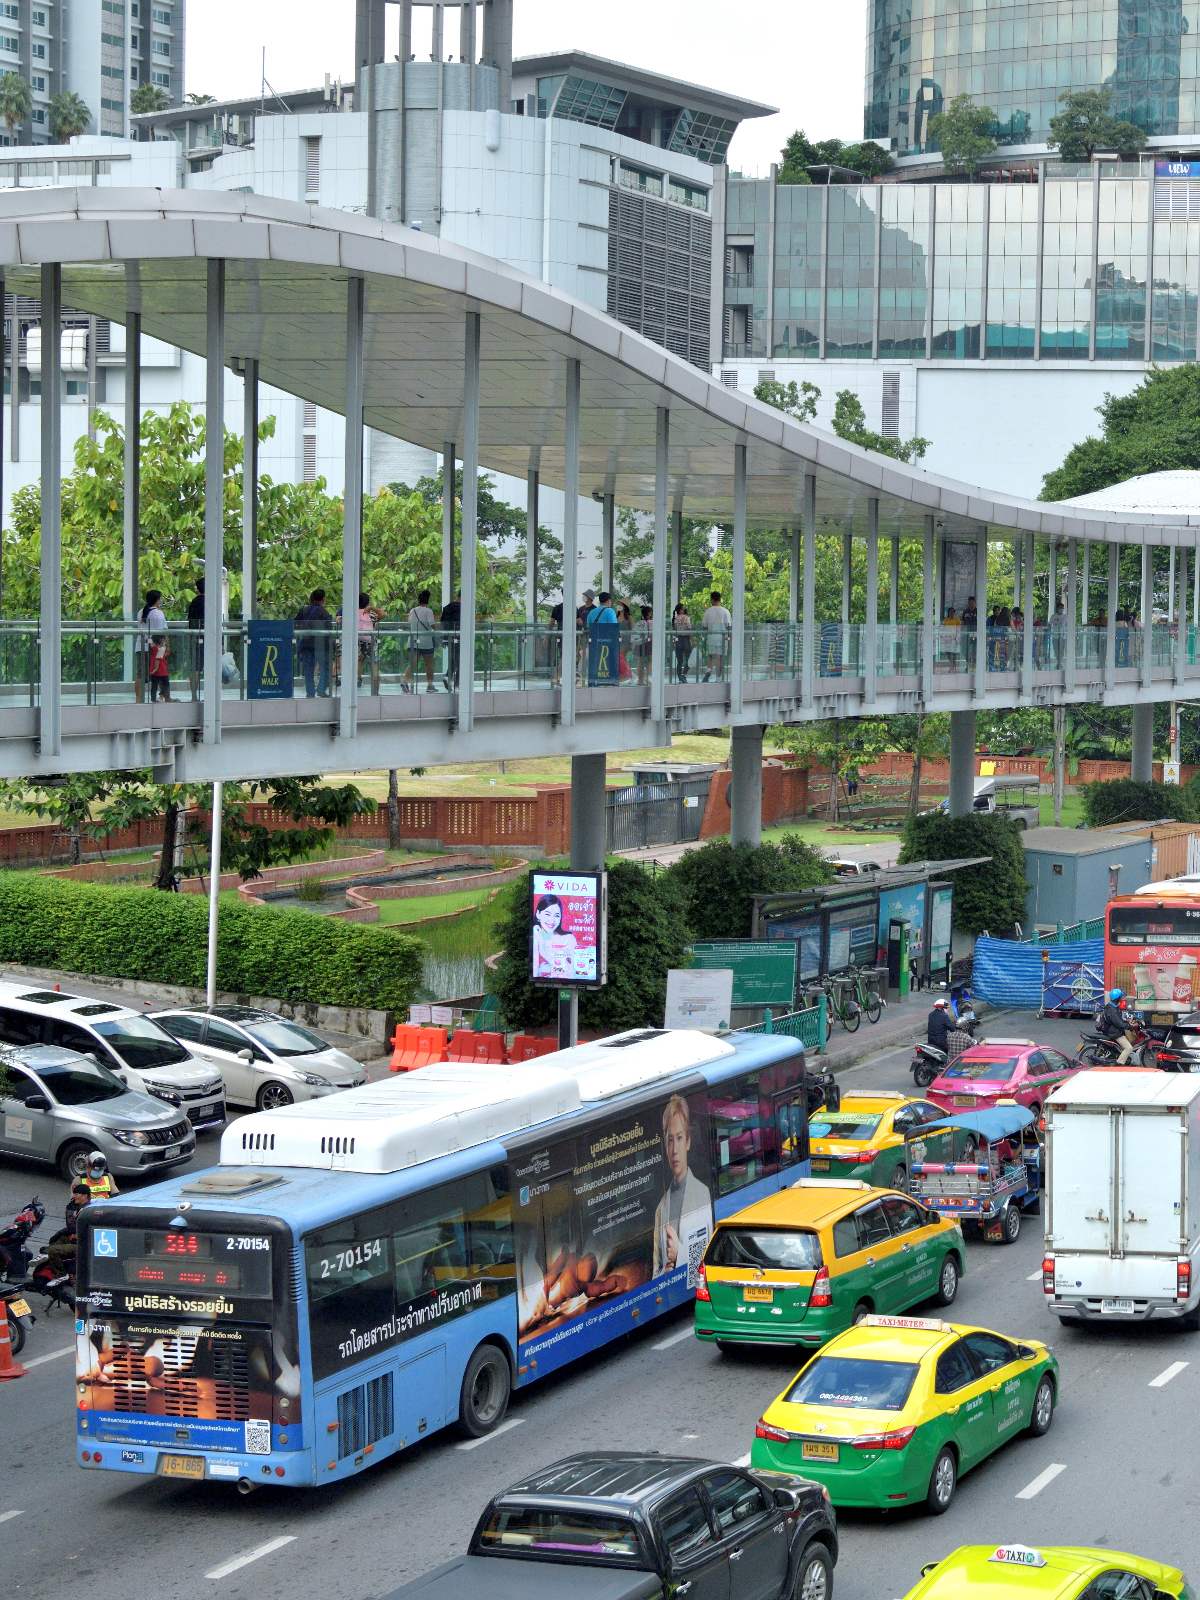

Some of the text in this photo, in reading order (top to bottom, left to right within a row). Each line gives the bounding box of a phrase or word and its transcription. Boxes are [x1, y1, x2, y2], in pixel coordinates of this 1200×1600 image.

[262, 645, 278, 677] R
[598, 645, 609, 670] R
[262, 678, 279, 686] WALK
[556, 882, 588, 892] VIDA
[590, 1122, 644, 1158] มูลนิธิสร้างรอยยิ้ม
[226, 1238, 270, 1250] 2-70154
[320, 1239, 381, 1278] 2-70154
[125, 1295, 234, 1314] มูลนิธิสร้างรอยยิ้ม
[878, 1318, 924, 1328] TAXI-METER
[822, 1445, 834, 1454] 351
[166, 1457, 202, 1472] 16-1865
[1006, 1550, 1026, 1563] TAXI
